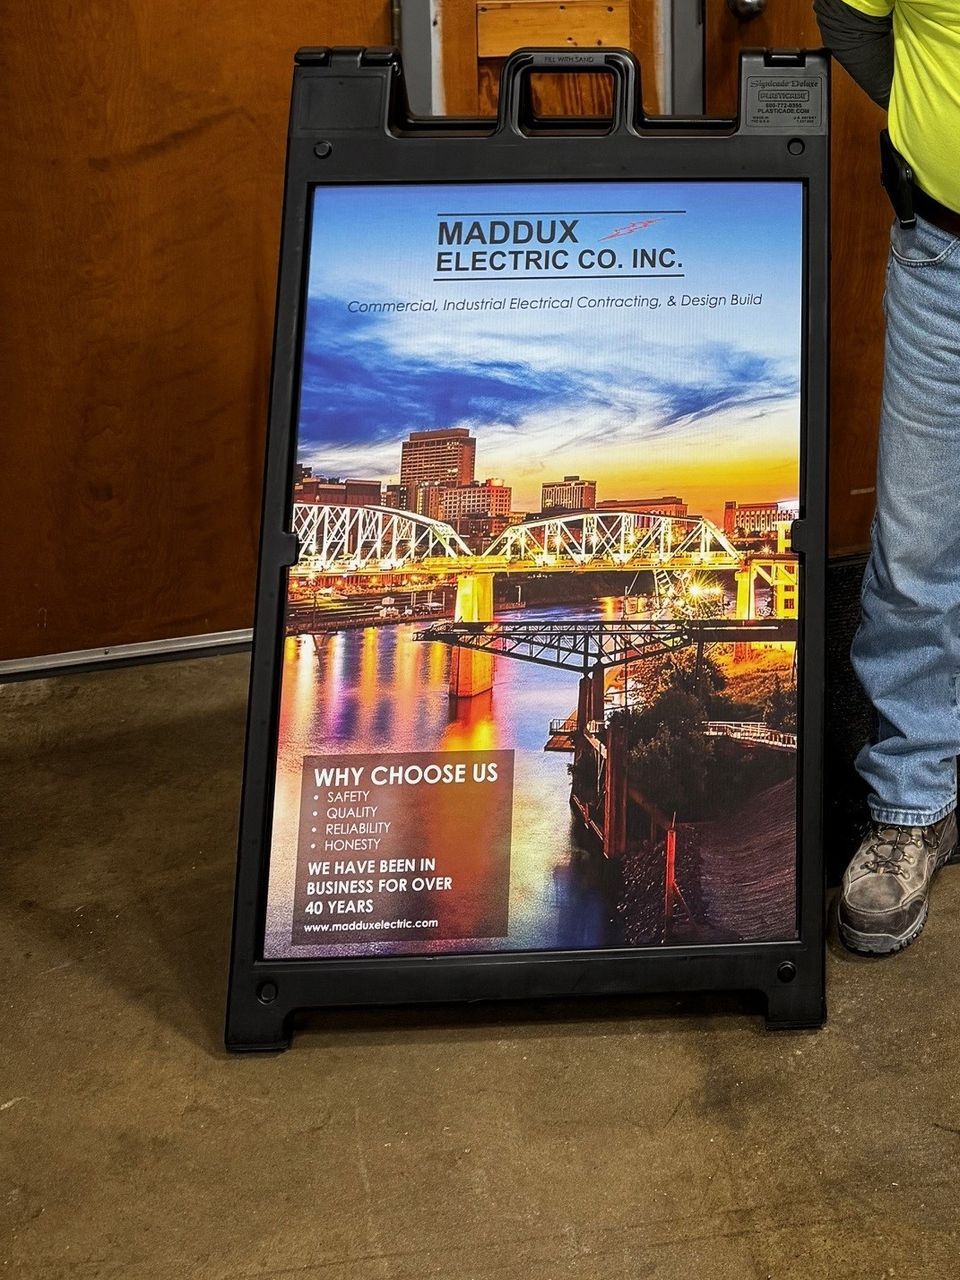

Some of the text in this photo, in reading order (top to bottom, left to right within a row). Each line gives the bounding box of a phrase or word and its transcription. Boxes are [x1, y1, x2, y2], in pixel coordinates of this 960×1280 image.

[437, 220, 579, 246] MADDUX
[436, 248, 683, 272] ELECTRIC CO. INC.
[347, 293, 763, 312] Commercial, Industrial Electrical Contracting, & Design Build
[314, 762, 498, 787] WHY CHOOSE US
[327, 790, 370, 803] SAFETY
[326, 806, 378, 820] QUALITY
[326, 822, 391, 835] RELIABILITY
[324, 838, 381, 851] HONESTY
[308, 858, 436, 876] WE HAVE BEEN IN
[307, 877, 453, 895] BUSINESS FOR OVER
[305, 899, 374, 915] 40 YEARS
[304, 918, 438, 932] www.madduxelectric.com
